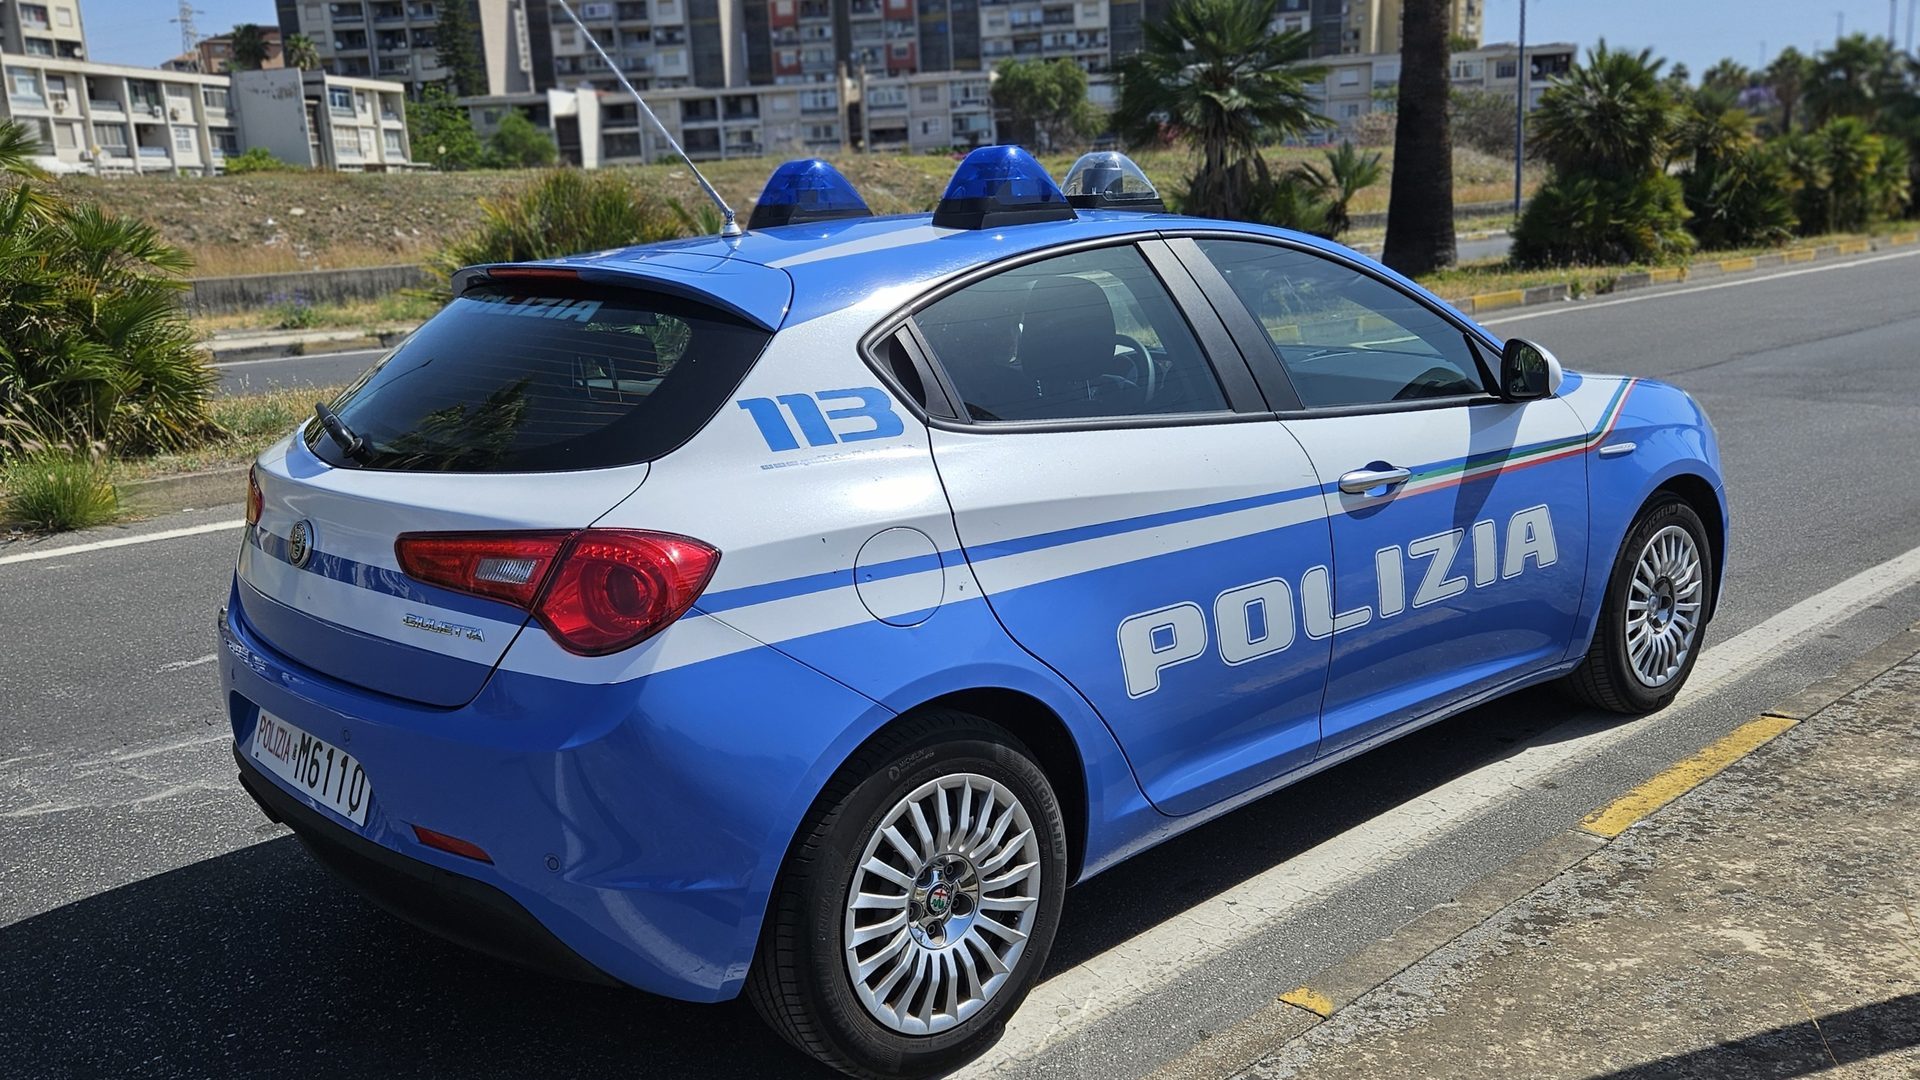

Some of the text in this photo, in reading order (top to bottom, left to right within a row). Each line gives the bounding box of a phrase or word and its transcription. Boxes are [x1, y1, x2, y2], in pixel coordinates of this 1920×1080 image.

[458, 295, 604, 322] OLIZIA
[736, 387, 905, 452] 113
[402, 613, 486, 642] GIULIETTA
[1117, 504, 1558, 700] POLIZIA
[257, 715, 366, 812] POLIZIA M6110
[1026, 768, 1064, 854] MICHELIN
